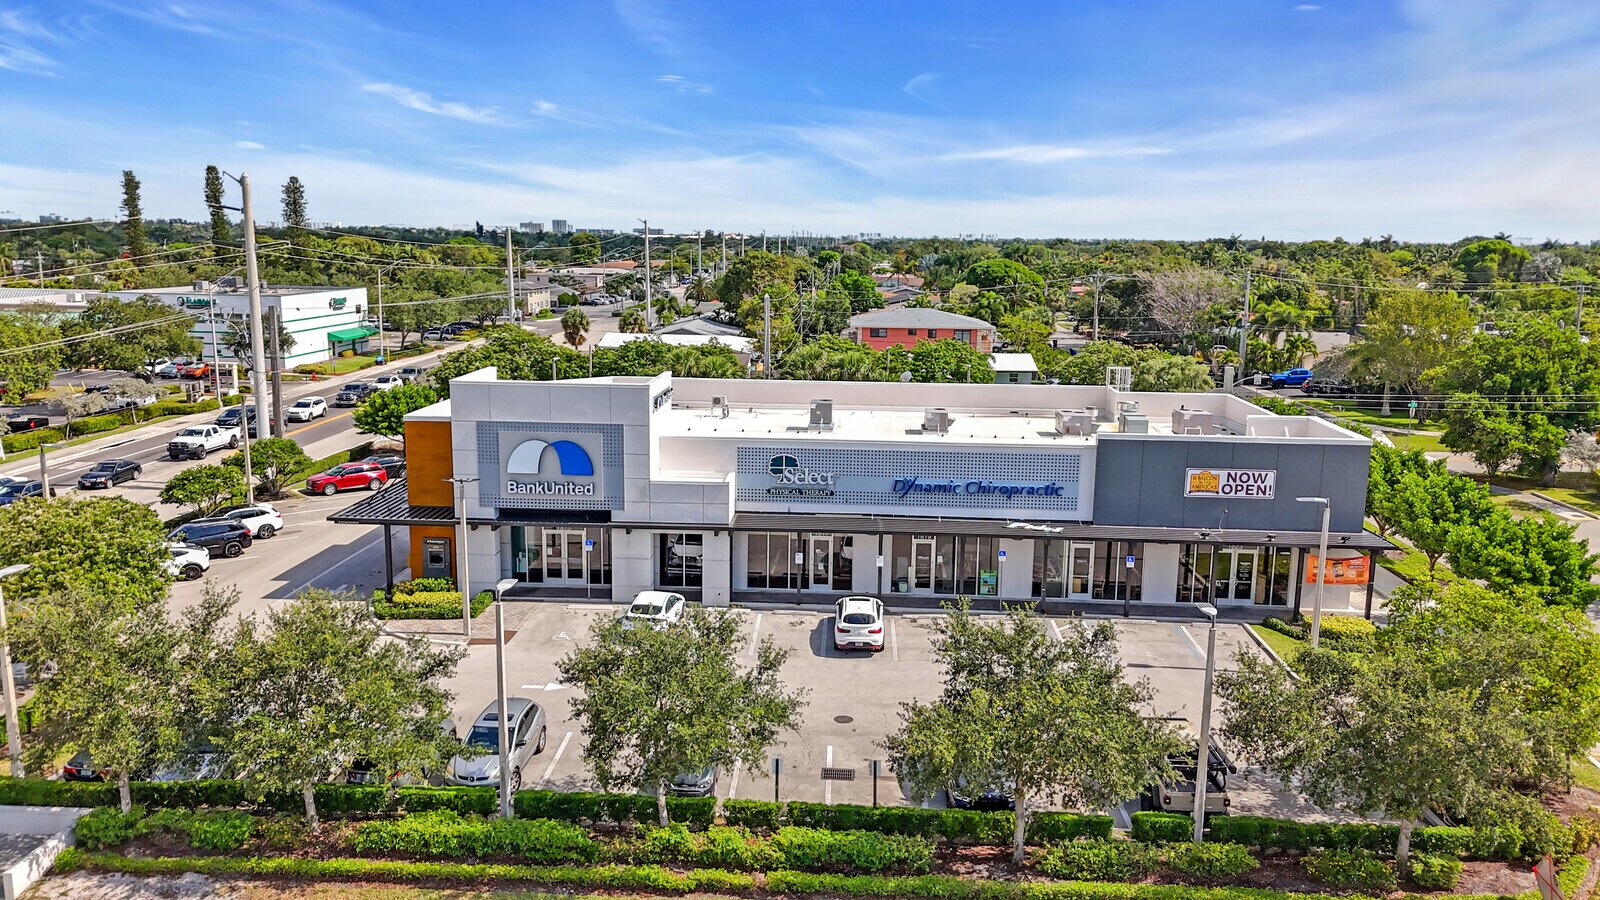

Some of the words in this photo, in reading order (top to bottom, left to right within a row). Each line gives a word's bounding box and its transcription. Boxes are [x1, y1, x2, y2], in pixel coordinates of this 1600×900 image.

[784, 468, 834, 484] Select
[1226, 472, 1268, 484] NOW
[507, 481, 594, 496] BankUnited
[892, 476, 962, 498] Dynamic
[966, 481, 1064, 499] Chiropractic
[1221, 484, 1272, 496] OPEN!
